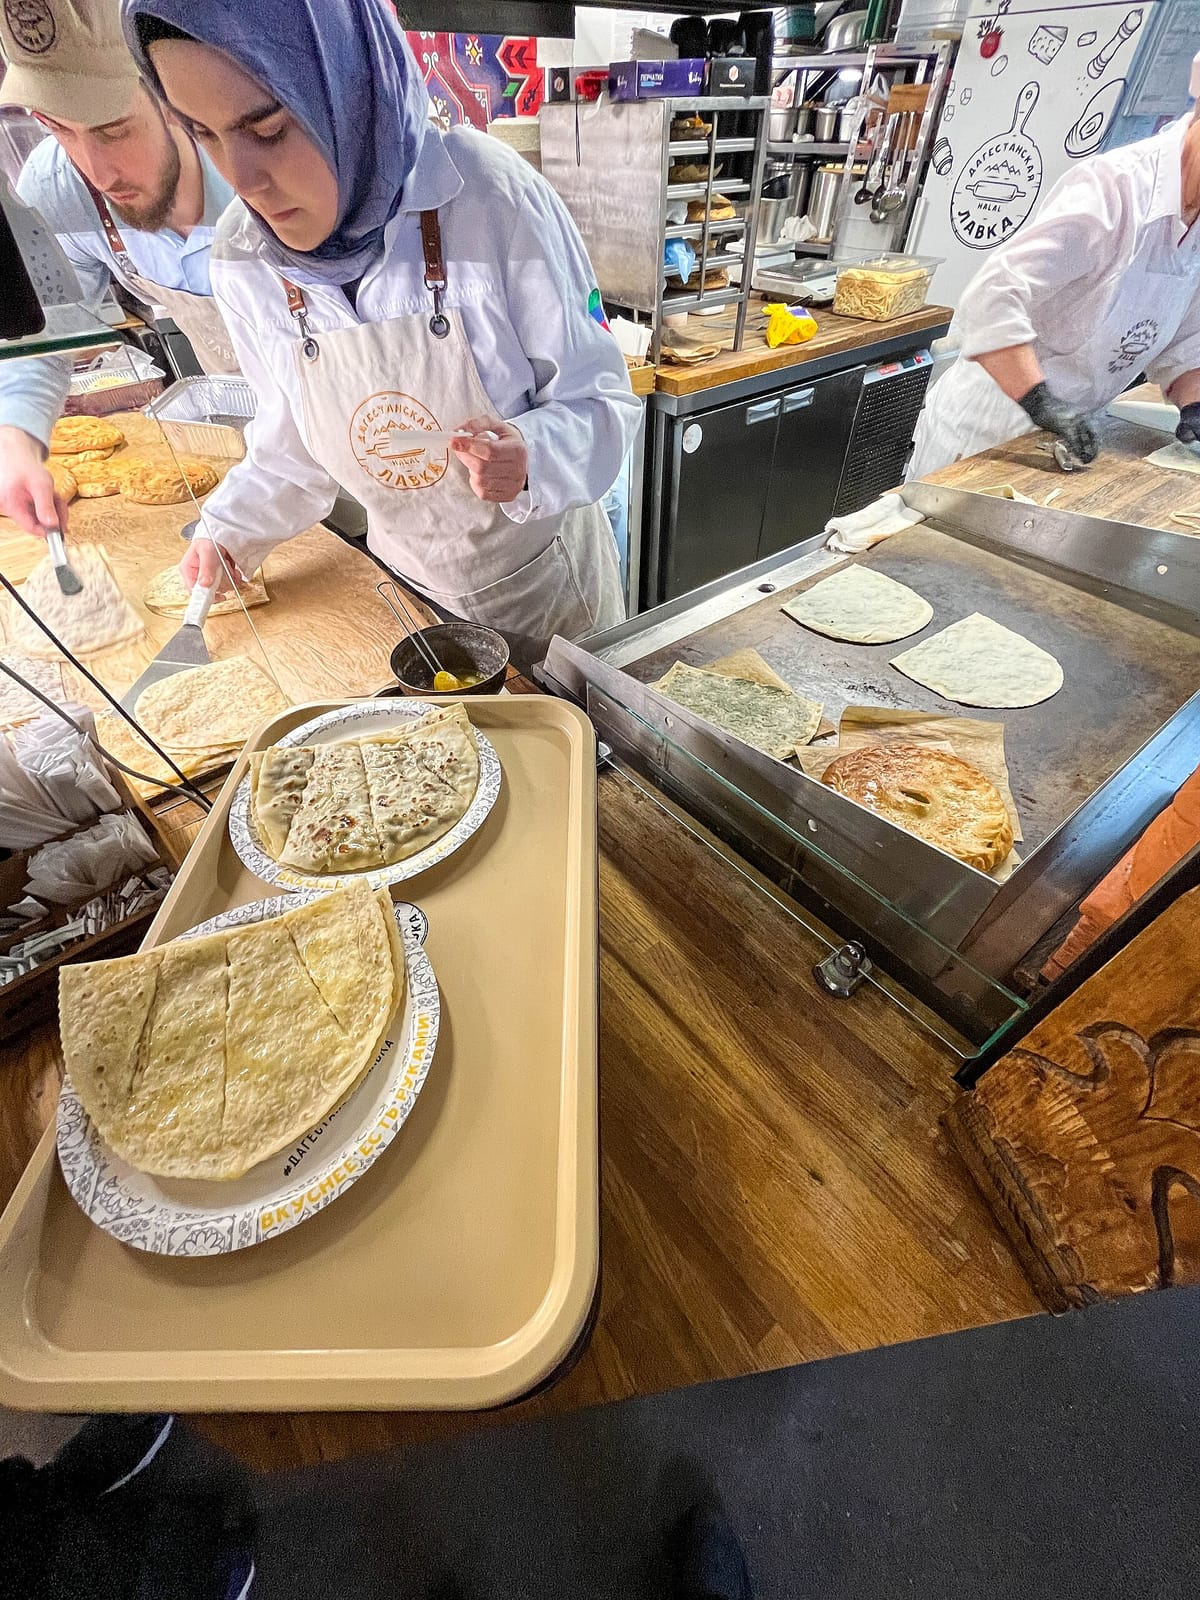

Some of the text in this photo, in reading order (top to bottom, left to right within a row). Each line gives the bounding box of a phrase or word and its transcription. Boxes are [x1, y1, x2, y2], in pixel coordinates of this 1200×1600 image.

[640, 73, 664, 82] ПЕРЧАТКИ
[968, 142, 1036, 183] ДАГЕСТАНСКАЯ
[977, 202, 1002, 213] HALAL
[957, 209, 1014, 239] ЛАВКА
[357, 403, 434, 445] ДАГЕСТАНСКАЯ
[377, 462, 444, 487] ЛАВКА
[391, 457, 420, 467] HALAL
[261, 1015, 431, 1231] ВКУСНЕЕ ЕСТЬ РУКАМИ
